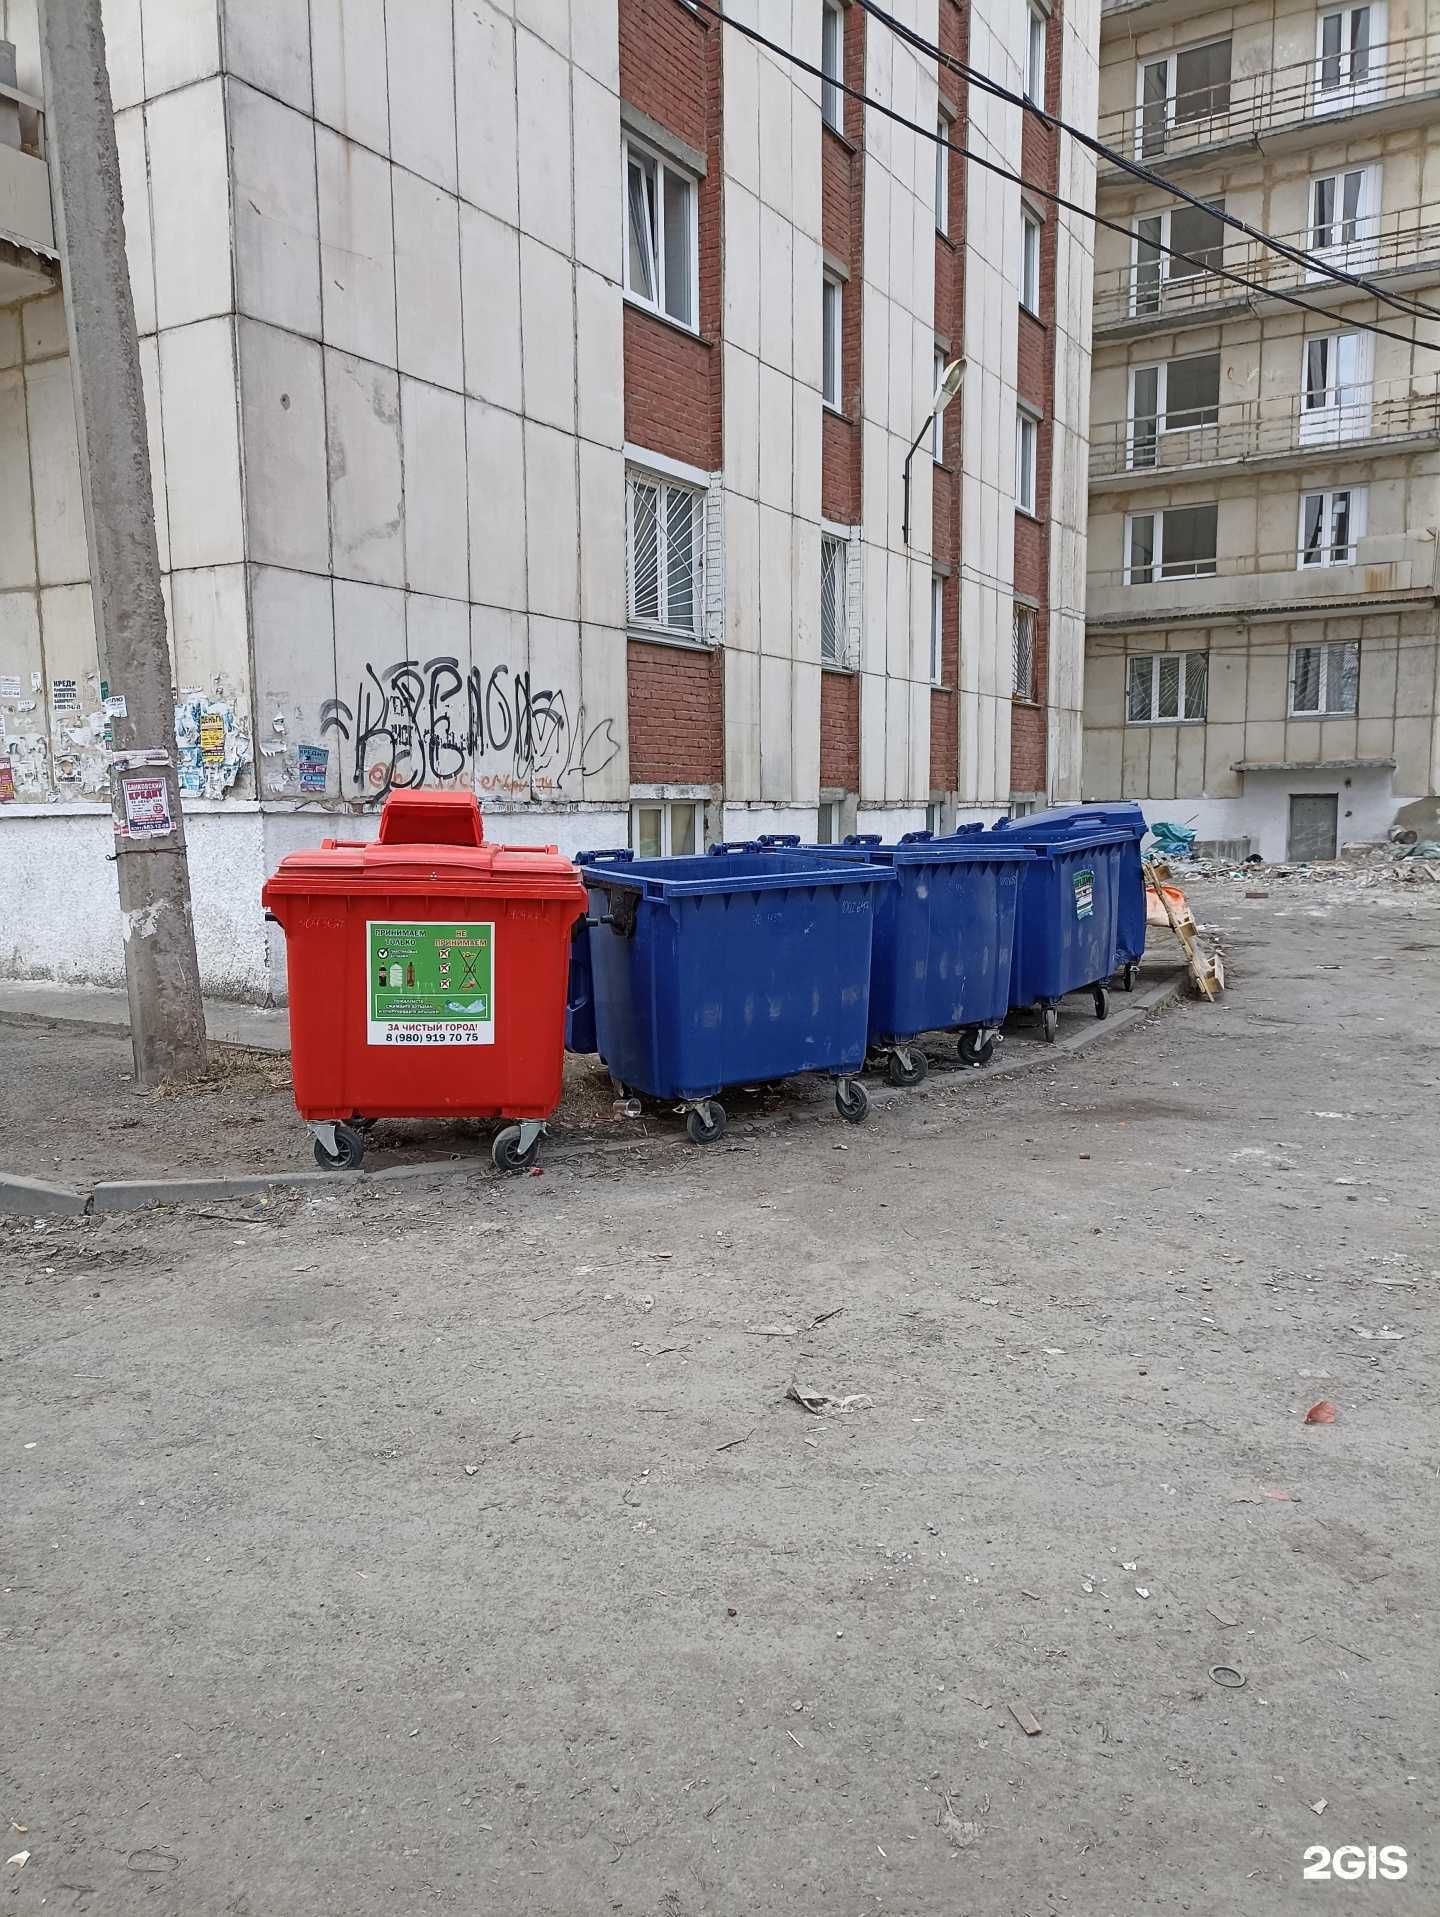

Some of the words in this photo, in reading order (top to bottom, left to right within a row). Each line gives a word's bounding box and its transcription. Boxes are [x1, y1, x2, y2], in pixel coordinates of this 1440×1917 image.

[128, 789, 162, 800] КРЕДИТ
[375, 929, 427, 937] ПРИНИМАЕМ
[385, 938, 416, 946] ТОЛЬКО
[435, 939, 487, 947] ПРИНИМАЕМ
[388, 1023, 400, 1031] ЗА
[402, 1023, 443, 1032] ЧИСТЫЙ
[445, 1023, 478, 1032] ГОРОД!
[386, 1033, 392, 1042] 8
[395, 1033, 423, 1043] (980)
[425, 1033, 446, 1042] 919
[449, 1033, 462, 1042] 70
[465, 1033, 479, 1042] 75
